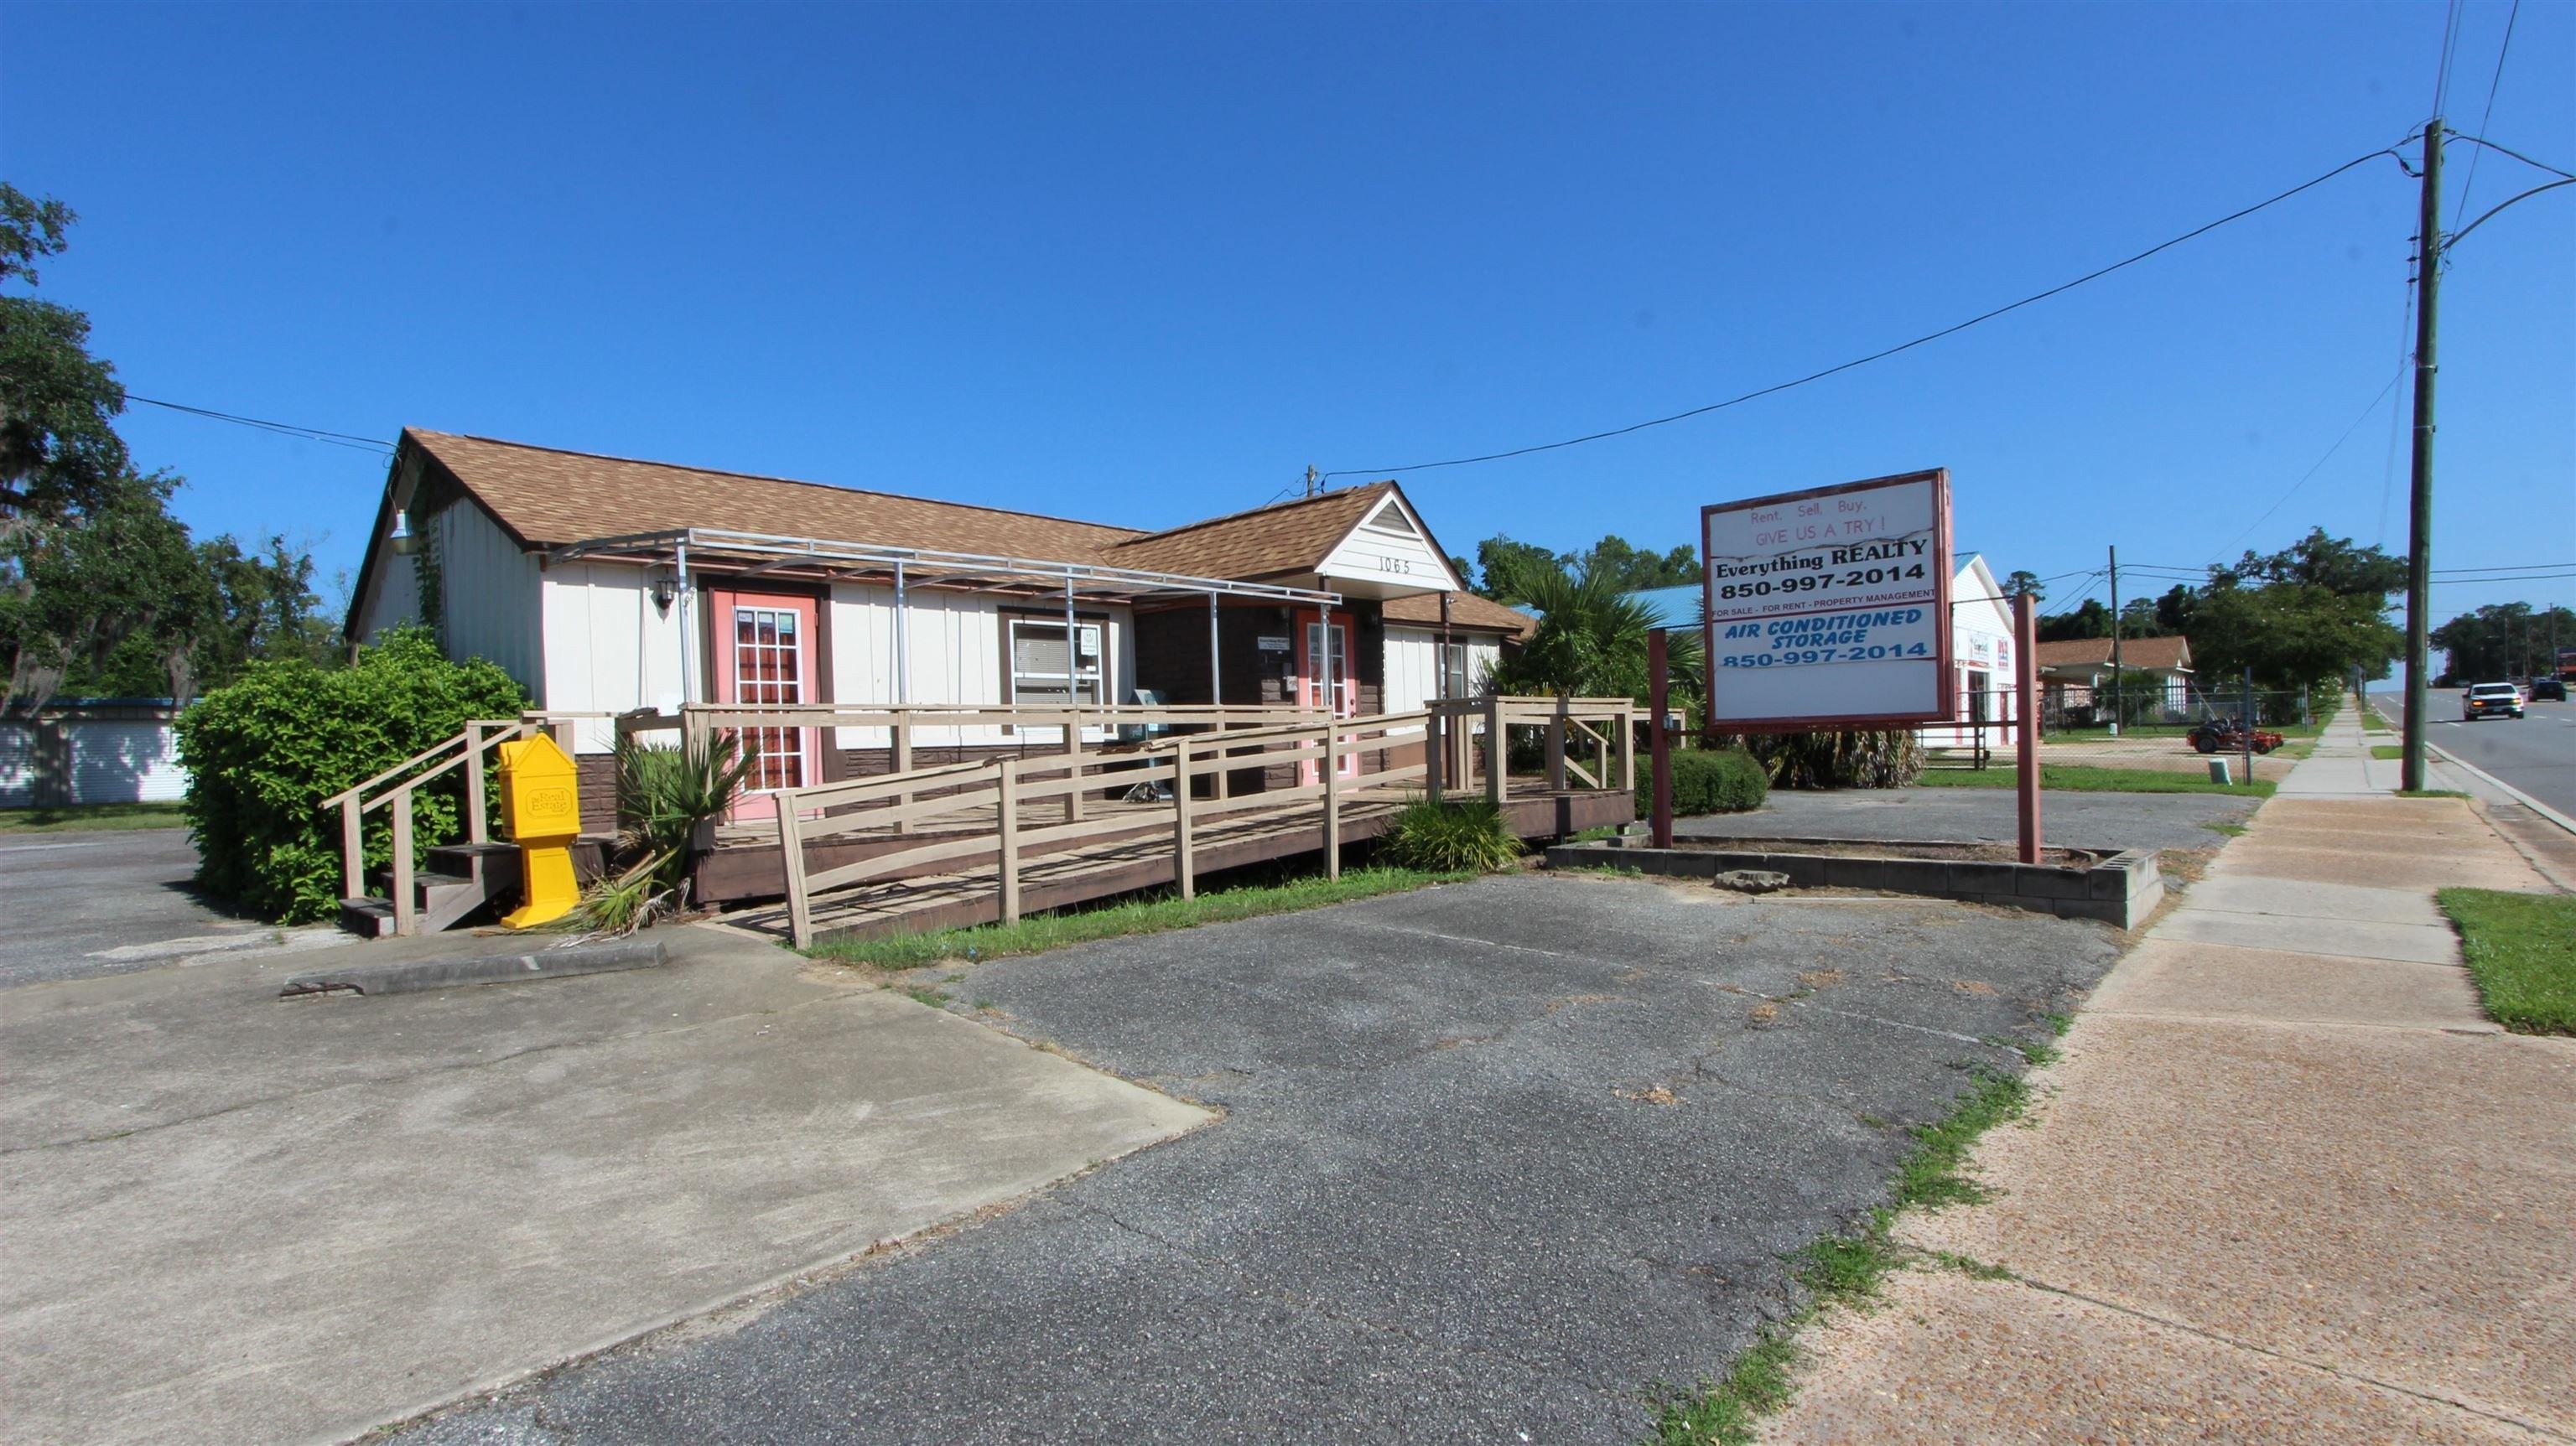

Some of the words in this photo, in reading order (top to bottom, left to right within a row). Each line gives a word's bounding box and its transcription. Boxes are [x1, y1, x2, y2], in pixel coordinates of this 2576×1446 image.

[1750, 511, 1782, 526] Rent.
[1838, 500, 1867, 516] Buy.
[1755, 530, 1788, 547] GIVE
[1796, 526, 1816, 541] US
[1824, 524, 1836, 538] A
[1379, 557, 1410, 574] 1065
[1716, 555, 1824, 578] Everything
[1831, 538, 1929, 565] REALTY
[1721, 563, 1925, 600] 850-997-2014
[1711, 609, 1729, 618] FOR
[1731, 606, 1753, 616] SALE
[1763, 603, 1781, 613] FOR
[1782, 601, 1806, 611] RENT
[1814, 595, 1864, 609] PROPERTY
[1866, 588, 1935, 604] MANAGEMENT
[1725, 623, 1761, 640] AIR
[1767, 609, 1923, 636] CONDITIONED
[1771, 629, 1868, 650] STORAGE
[1722, 641, 1928, 667] 850-997-2014
